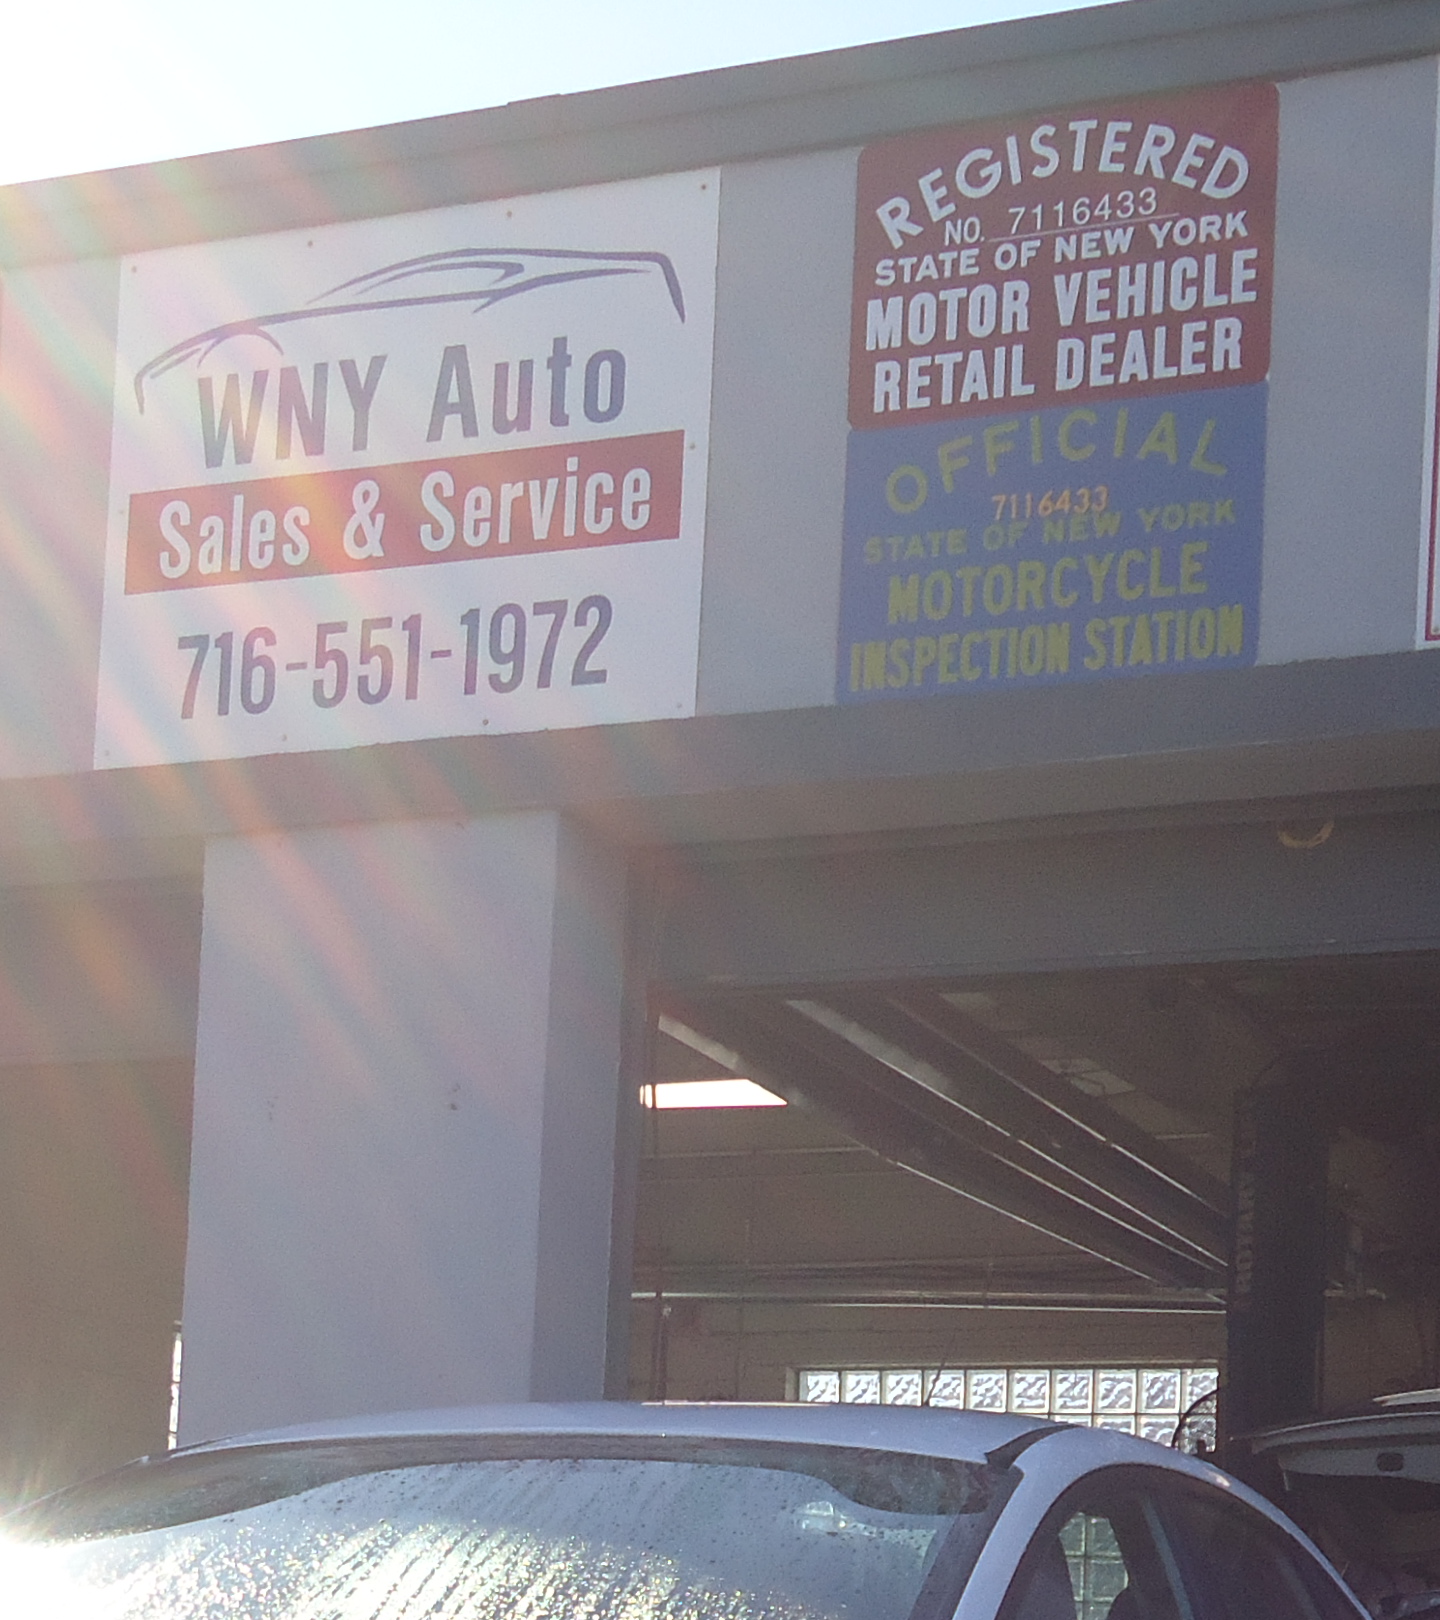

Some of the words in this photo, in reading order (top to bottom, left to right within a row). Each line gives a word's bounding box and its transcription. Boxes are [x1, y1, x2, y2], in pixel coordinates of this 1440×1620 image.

[875, 118, 1250, 250] REGISTERED
[943, 216, 986, 247] NO.
[1008, 186, 1157, 235] 7116433
[874, 248, 980, 287] STATE
[994, 239, 1041, 272] OF
[1054, 227, 1135, 263] NEW
[1150, 210, 1249, 249] YORK
[865, 279, 1030, 351] MOTOR
[1054, 248, 1258, 327] VEHICLE
[197, 354, 388, 470] WNY
[425, 335, 627, 443] Auto
[873, 344, 1036, 413] RETAIL
[1055, 316, 1244, 392] DEALER
[885, 407, 1228, 514] OFFICIAL
[991, 485, 1110, 521] 7116433
[159, 493, 311, 579] Sales
[343, 478, 386, 560] &
[419, 455, 652, 553] Service
[863, 528, 968, 566] STATE
[982, 520, 1029, 551] OF
[1043, 511, 1122, 545] NEW
[1137, 498, 1237, 533] YORK
[887, 540, 1209, 625] MOTORCYCLE
[177, 593, 614, 720] 716-551-1972
[850, 622, 1071, 692] INSPECTION
[1083, 603, 1245, 671] STATION
